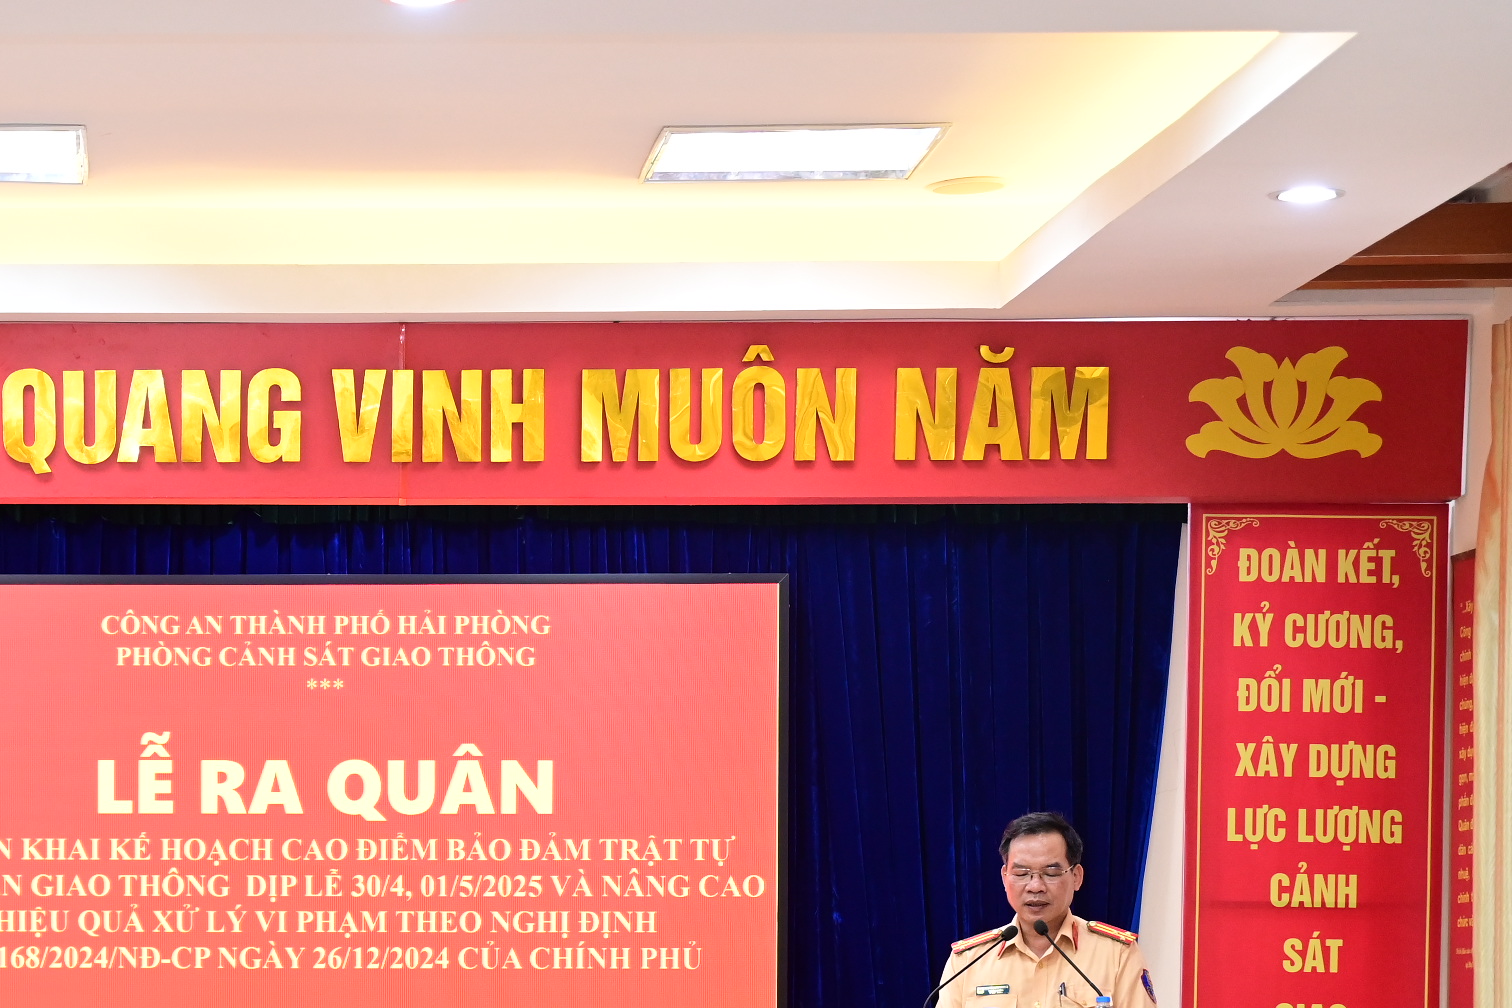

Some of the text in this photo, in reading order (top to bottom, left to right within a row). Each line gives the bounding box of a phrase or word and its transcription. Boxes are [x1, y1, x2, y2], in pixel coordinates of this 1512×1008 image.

[2, 368, 301, 474] QUANG
[332, 369, 545, 462] VINH
[581, 345, 857, 462] MUÔN
[895, 345, 1109, 460] NĂM
[1238, 539, 1399, 587] ĐOÀN KẾT,
[101, 609, 550, 634] CÔNG AN THÀNH PHỐ HẢI PHÒNG
[1234, 601, 1402, 653] KỶ CƯƠNG,
[117, 641, 535, 666] PHÒNG CẢNH SÁT GIAO THÔNG
[1237, 664, 1290, 712] ĐỔI
[1303, 672, 1363, 713] MỚI
[98, 731, 553, 821] LỄ RA QUÂN
[1235, 736, 1395, 785] XÂY DỰNG
[21, 838, 100, 860] KHAI
[109, 832, 150, 860] KẾ
[161, 838, 273, 866] HOẠCH
[282, 839, 348, 860] CAO
[356, 833, 438, 860] ĐIỂM
[447, 832, 511, 861] BẢO
[519, 832, 591, 860] ĐẢM
[599, 835, 682, 866] TRẬT
[690, 836, 735, 866] TỰ
[1227, 805, 1402, 851] LỰC LƯỢNG
[31, 874, 110, 896] GIAO
[118, 867, 230, 897] THÔNG
[247, 875, 297, 902] DỊP
[305, 869, 342, 896] LỄ
[351, 875, 412, 901] 30/4,
[421, 875, 542, 897] 01/5/2025
[550, 869, 593, 896] VÀ
[602, 868, 690, 897] NÂNG
[699, 875, 764, 897] CAO
[1270, 862, 1357, 908] CẢNH
[78, 904, 144, 936] QUẢ
[153, 904, 199, 932] XỬ
[206, 904, 247, 932] LÝ
[255, 911, 287, 932] VI
[296, 911, 387, 938] PHẠM
[396, 911, 482, 933] THEO
[490, 911, 570, 938] NGHỊ
[578, 911, 657, 938] ĐỊNH
[218, 941, 305, 969] NGÀY
[313, 947, 449, 969] 26/12/2024
[458, 941, 522, 969] CỦA
[530, 941, 630, 969] CHÍNH
[642, 941, 701, 969] PHỦ
[1283, 932, 1343, 972] SÁT
